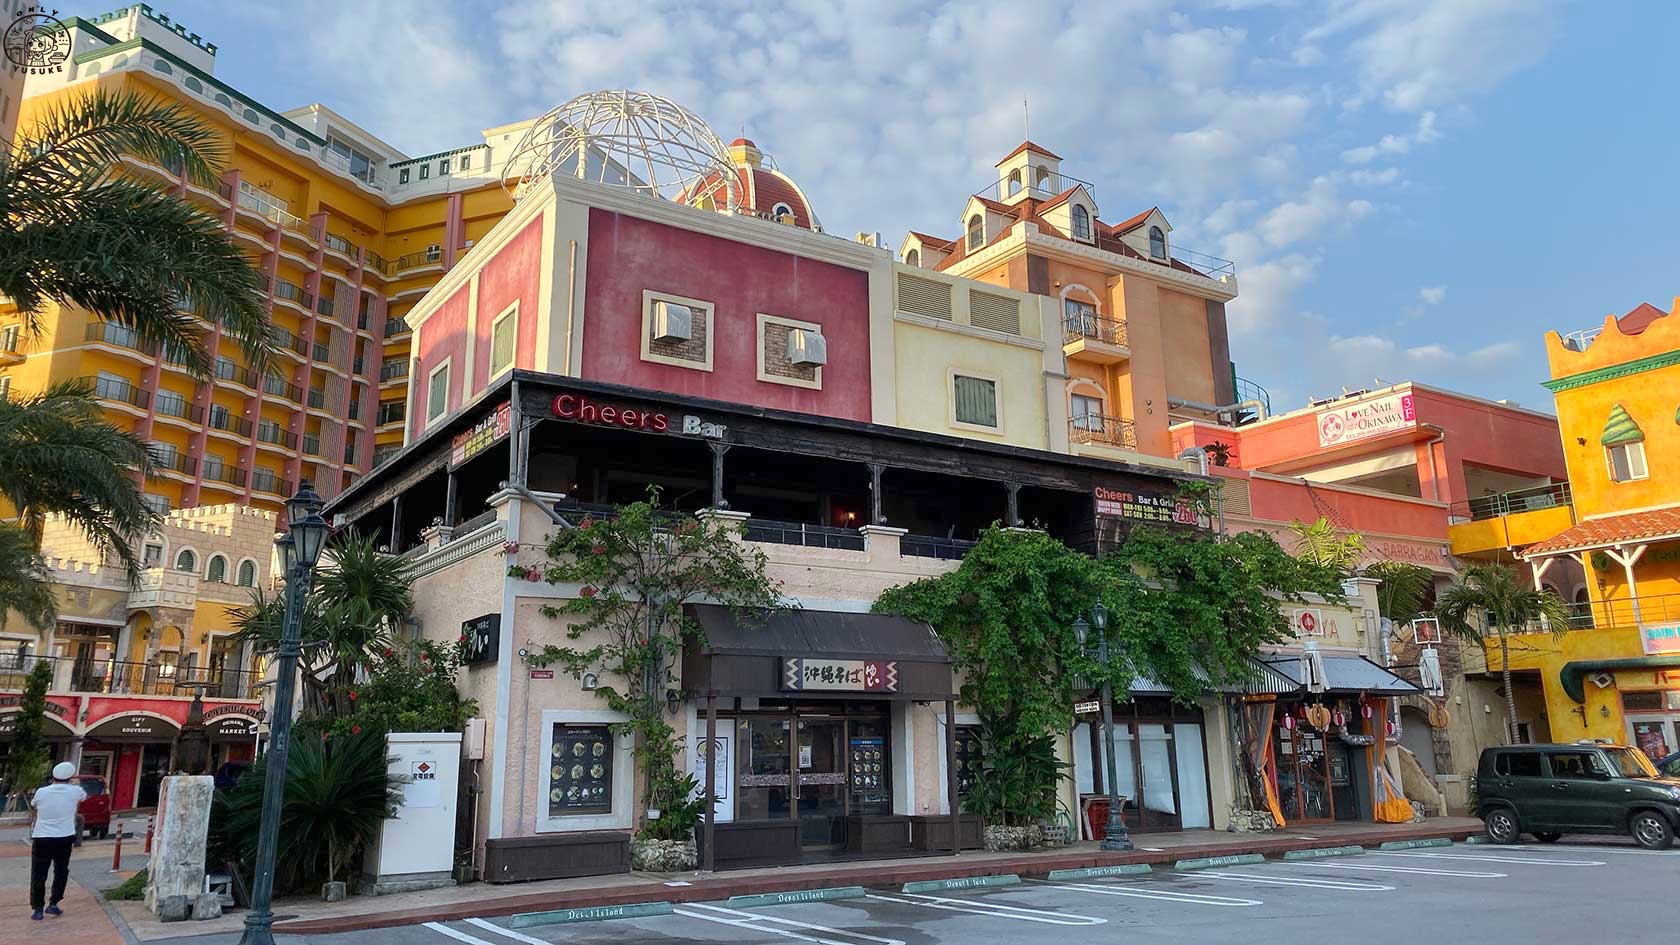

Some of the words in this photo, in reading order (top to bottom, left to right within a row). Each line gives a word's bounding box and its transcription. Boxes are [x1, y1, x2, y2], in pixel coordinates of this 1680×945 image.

[556, 394, 667, 430] Cheers
[682, 414, 727, 438] Bar
[1358, 412, 1402, 430] OKINAWA
[1095, 486, 1134, 502] Cheers
[1138, 495, 1152, 505] Bar
[804, 665, 863, 684] 沖縄そば
